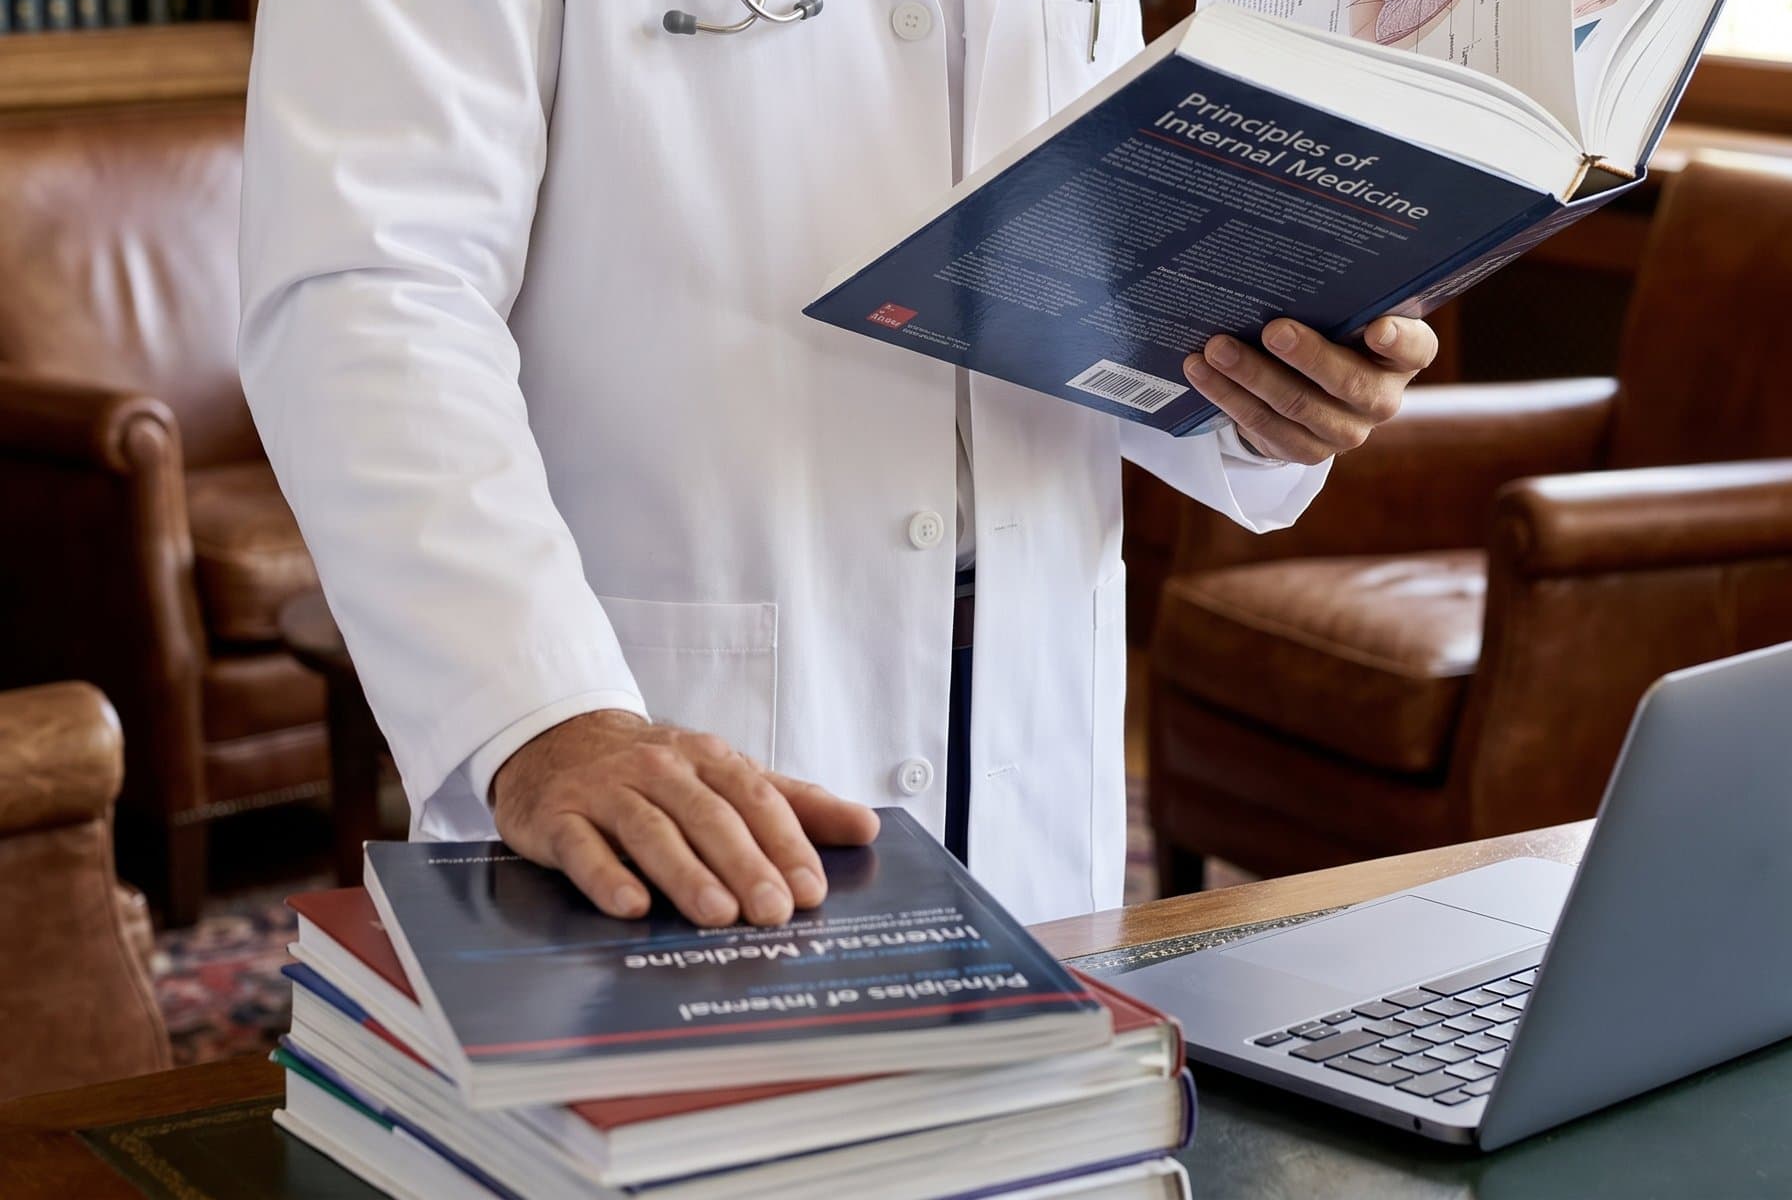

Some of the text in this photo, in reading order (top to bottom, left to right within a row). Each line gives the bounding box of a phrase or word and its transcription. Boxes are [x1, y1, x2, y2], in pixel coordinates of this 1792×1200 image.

[1154, 111, 1283, 167] Internal
[1286, 158, 1430, 221] Medicine
[1178, 92, 1379, 172] Principles of
[624, 939, 801, 970] Medicine
